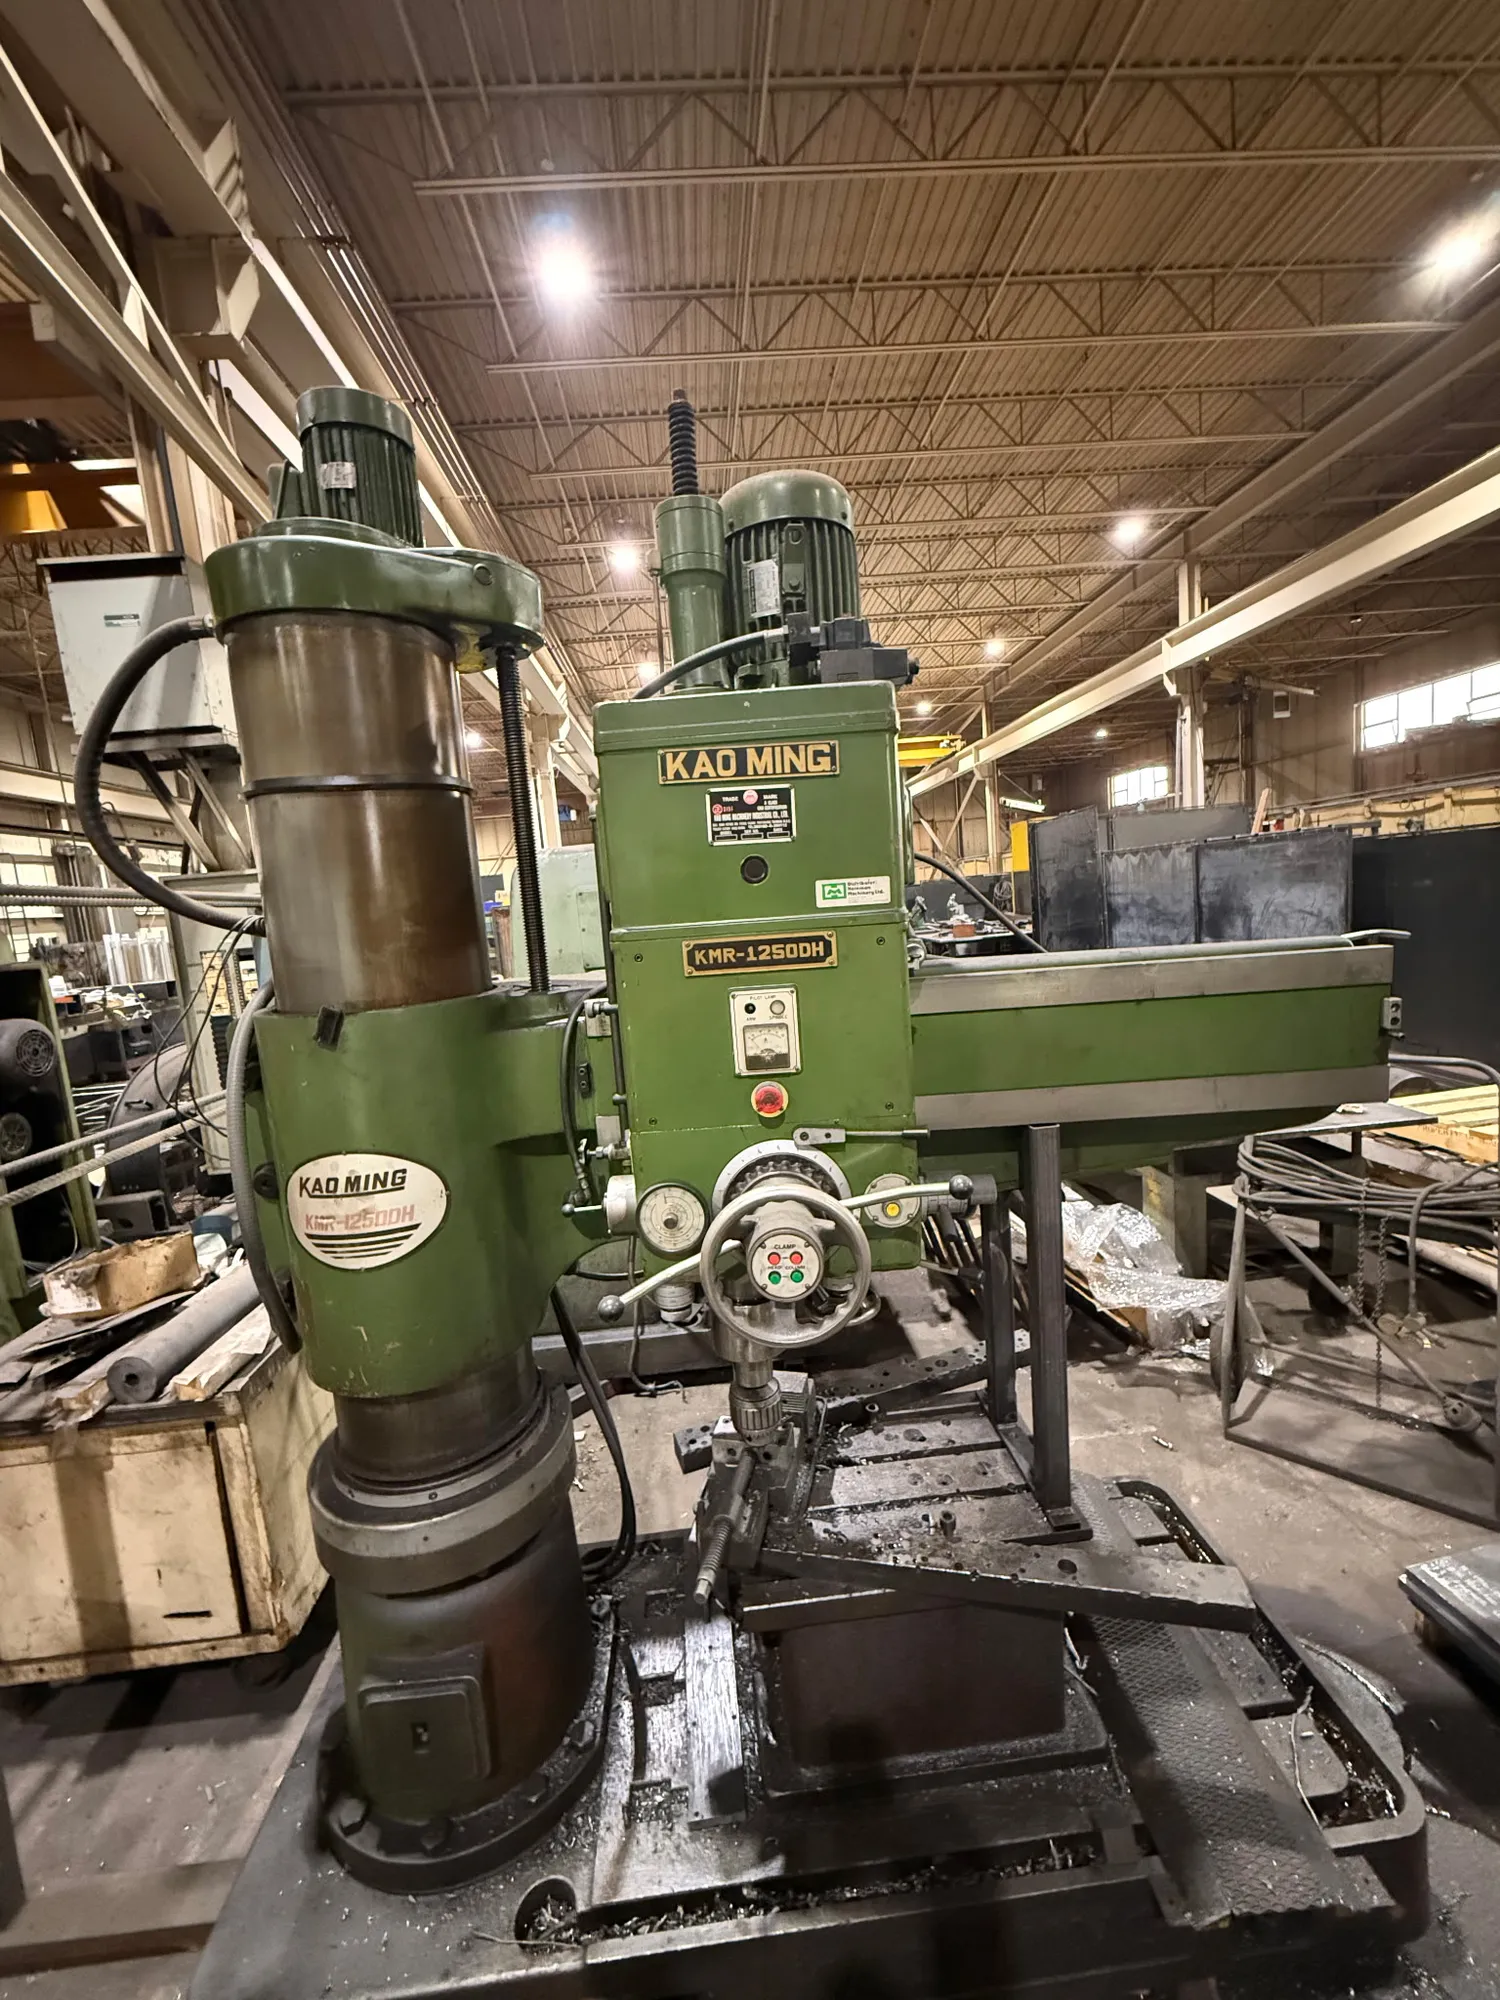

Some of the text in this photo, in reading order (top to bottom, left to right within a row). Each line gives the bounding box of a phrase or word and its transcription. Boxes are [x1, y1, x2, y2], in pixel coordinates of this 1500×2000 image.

[665, 743, 832, 780] KAO MING
[694, 941, 824, 965] KMR-1250DH
[299, 1168, 408, 1198] KAO MING
